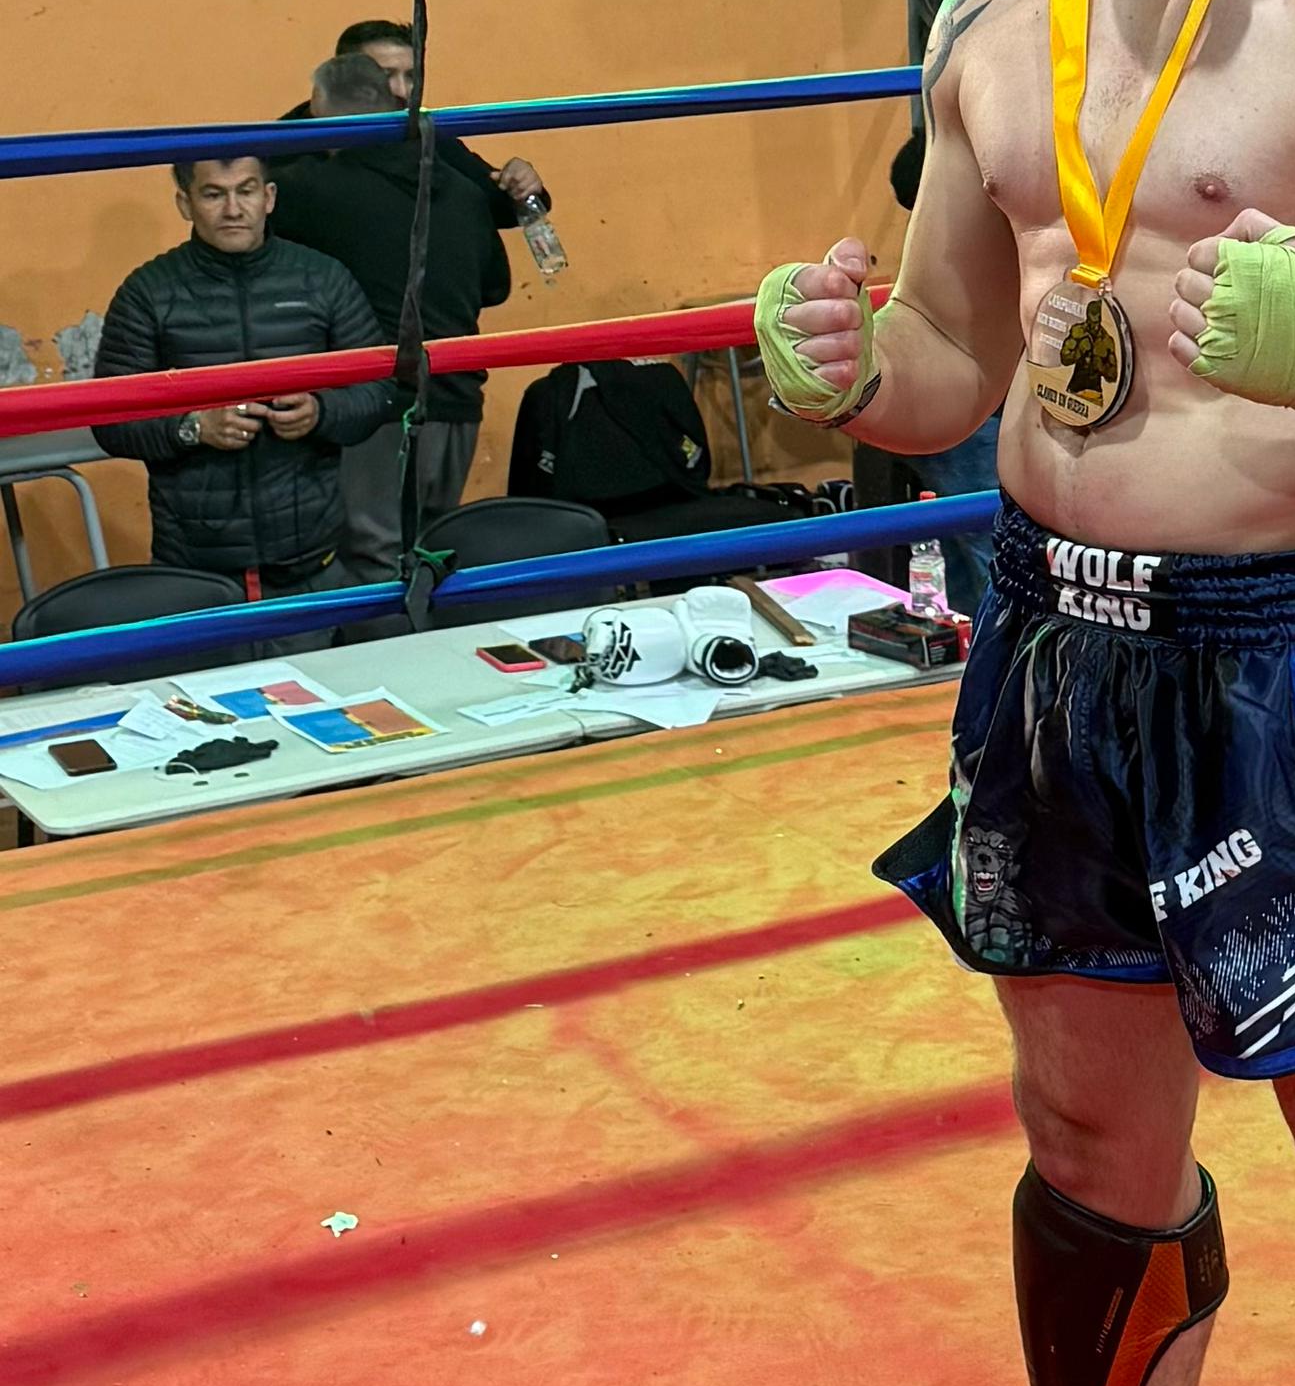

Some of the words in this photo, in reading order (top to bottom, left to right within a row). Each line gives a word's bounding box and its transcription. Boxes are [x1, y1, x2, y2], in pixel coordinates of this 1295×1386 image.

[1046, 537, 1161, 593] WOLF
[1057, 583, 1151, 632] KING
[1174, 827, 1263, 910] KING
